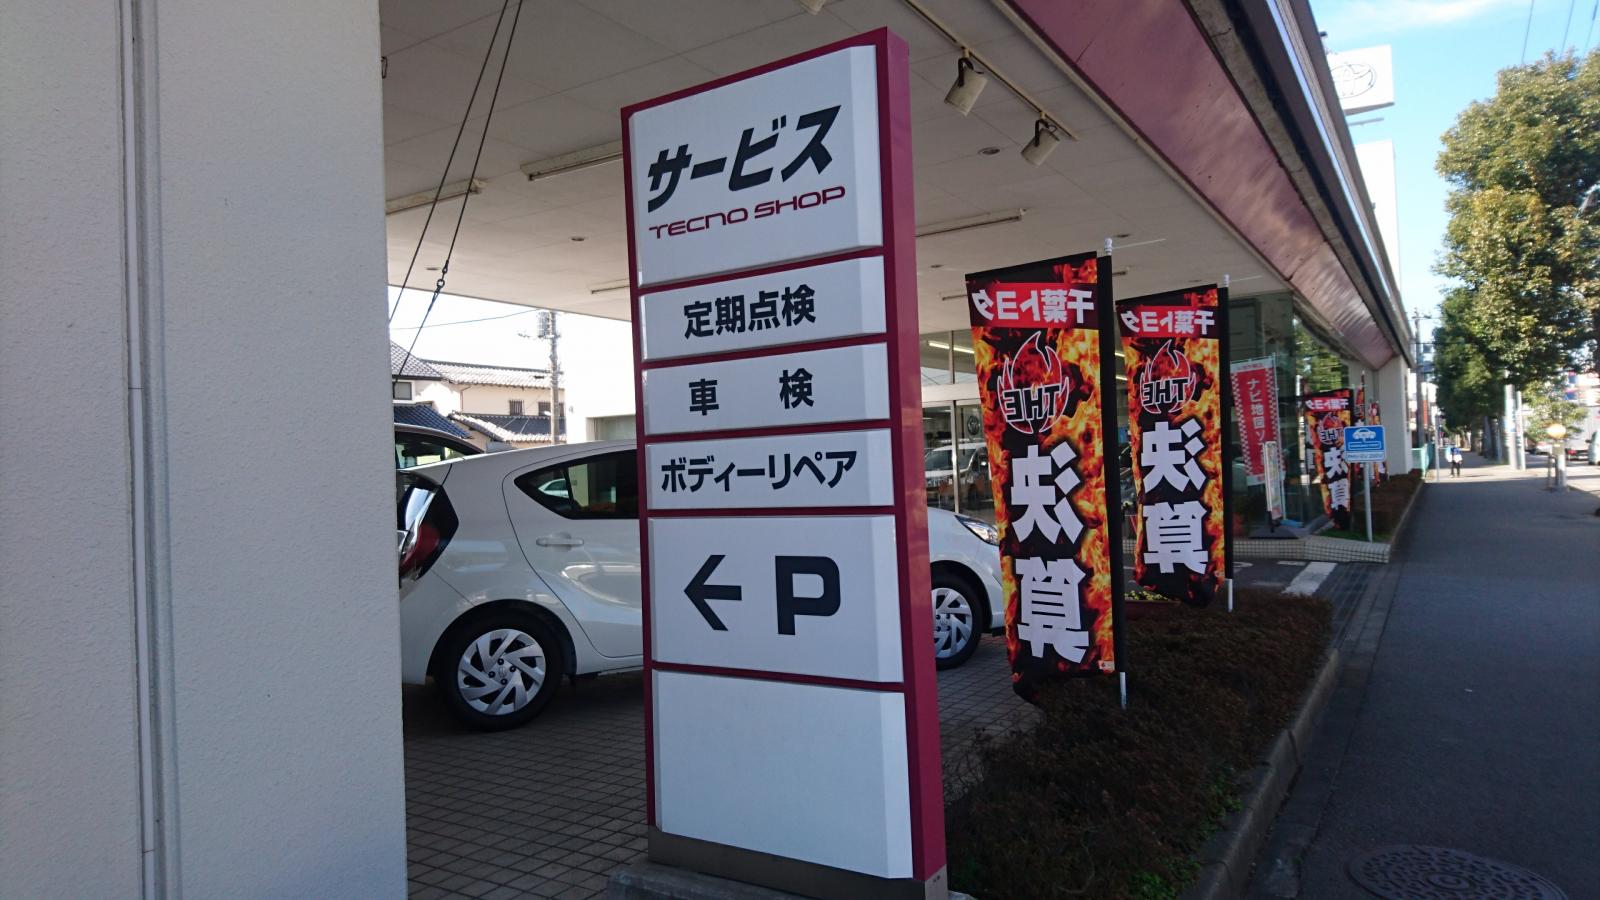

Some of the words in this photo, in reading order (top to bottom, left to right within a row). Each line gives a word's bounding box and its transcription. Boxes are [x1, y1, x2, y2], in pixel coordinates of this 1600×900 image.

[647, 104, 842, 214] サービス
[649, 206, 748, 240] TECNO
[754, 185, 846, 219] SHOP
[684, 283, 817, 340] 定期点検
[661, 450, 858, 493] ボディーリペア
[775, 555, 841, 636] P
